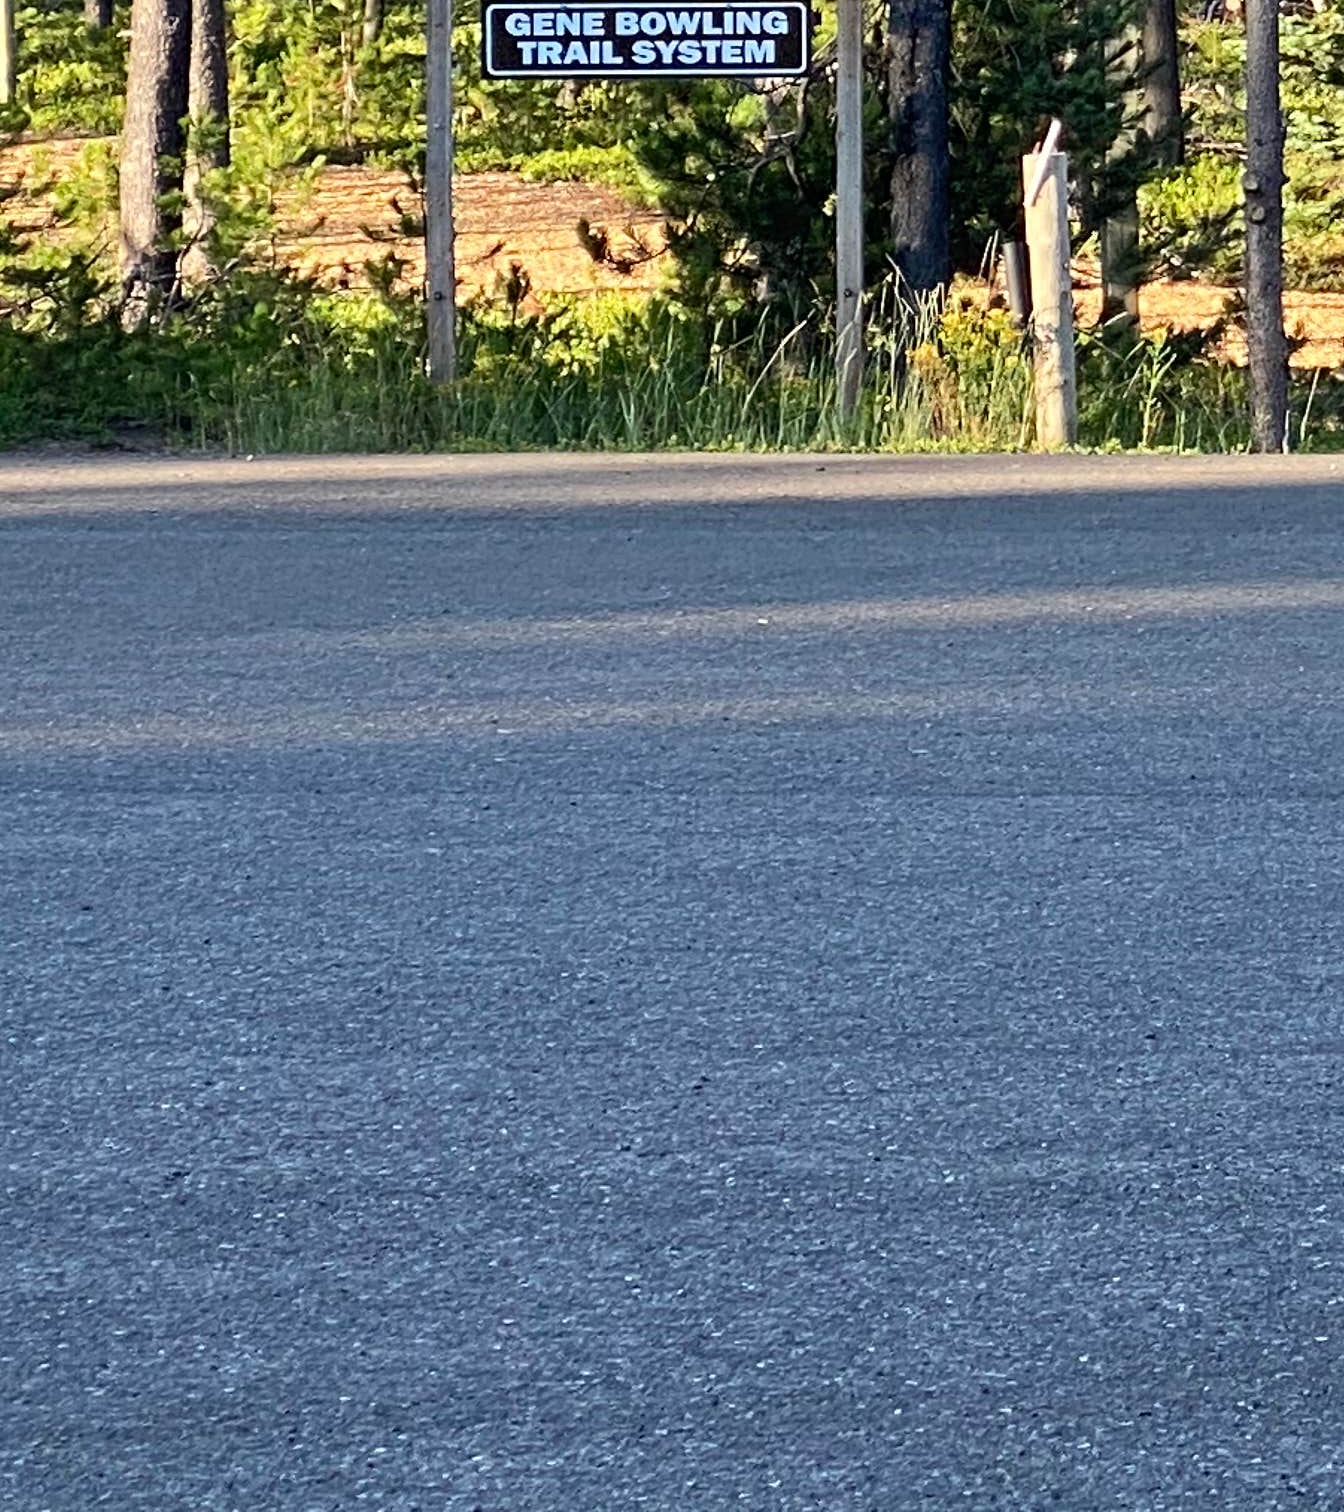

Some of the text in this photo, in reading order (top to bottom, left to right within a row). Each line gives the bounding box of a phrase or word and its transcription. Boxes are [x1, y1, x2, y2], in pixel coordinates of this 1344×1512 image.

[505, 11, 789, 36] GENE BOWLING
[517, 39, 776, 64] TRAIL SYSTEM
